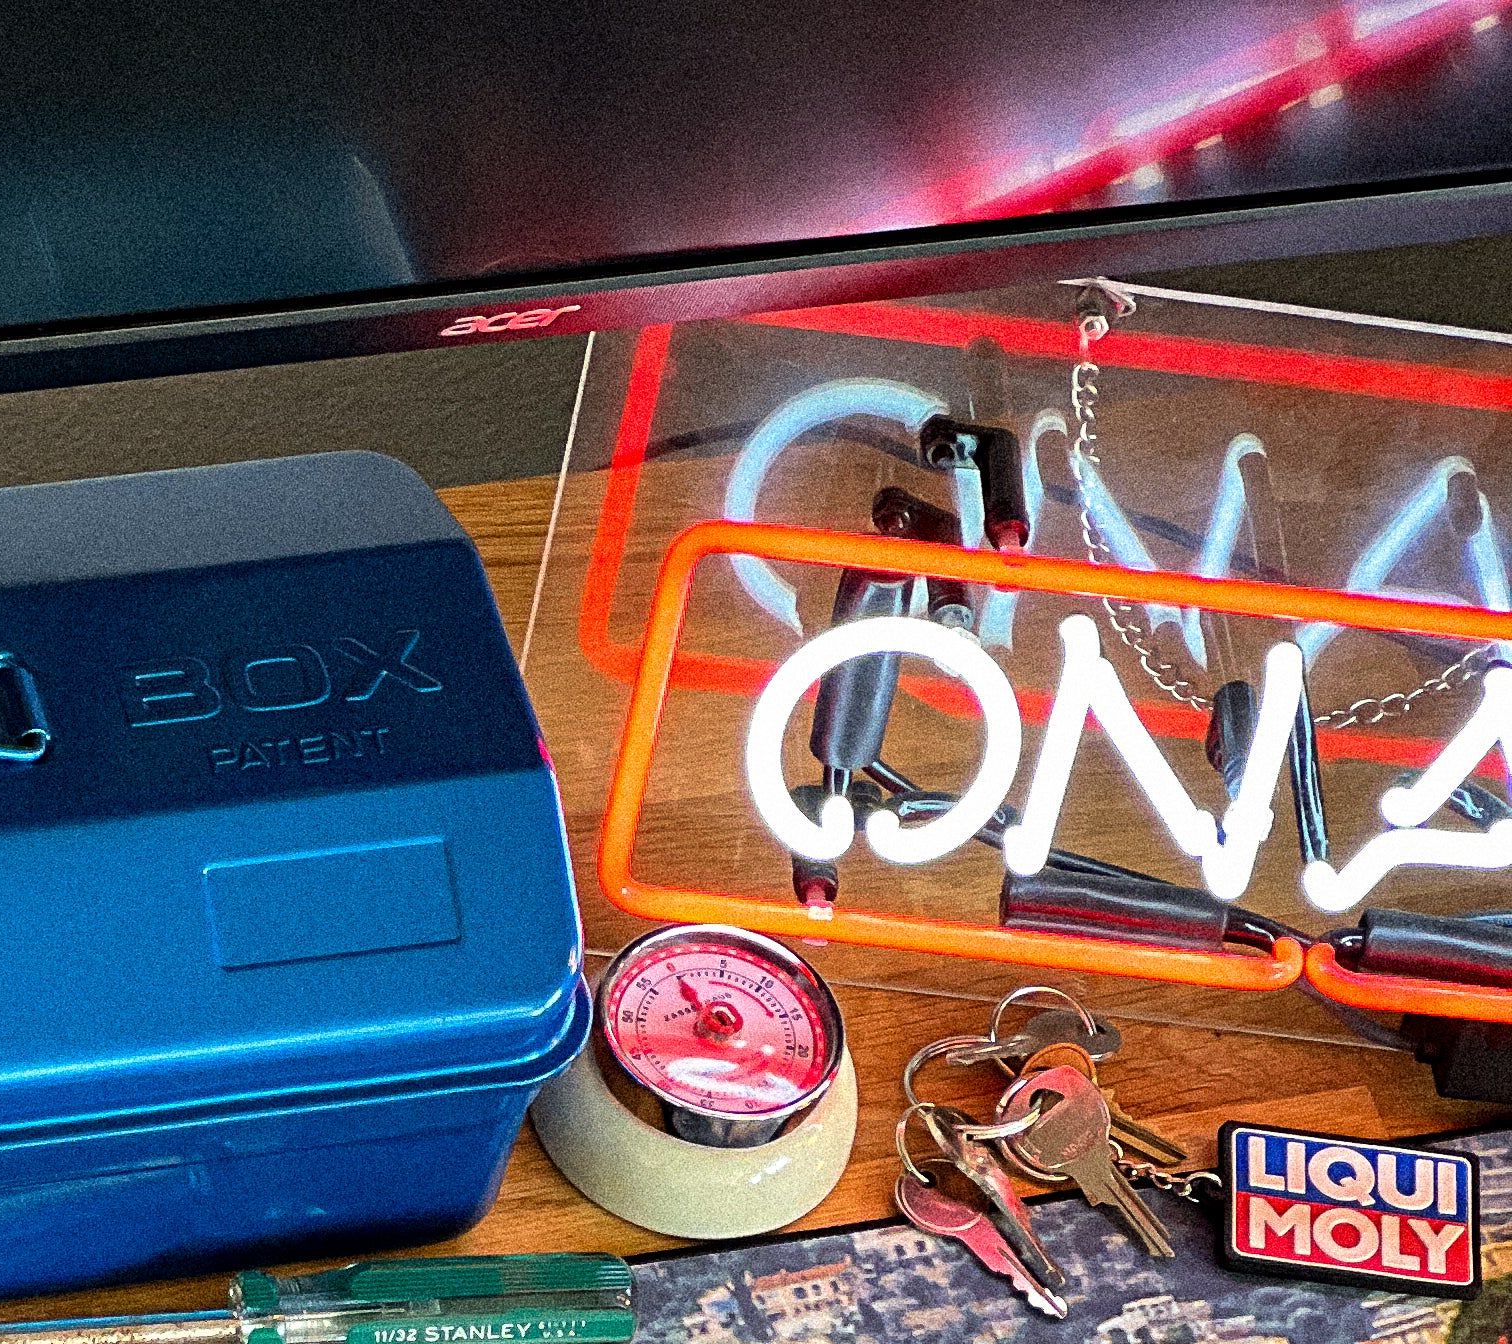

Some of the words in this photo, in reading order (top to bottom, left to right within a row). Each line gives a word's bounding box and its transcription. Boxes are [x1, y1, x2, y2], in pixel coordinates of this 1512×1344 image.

[440, 304, 582, 337] acer
[120, 628, 444, 730] BOX
[210, 726, 390, 774] PATENT
[718, 958, 729, 970] 5
[757, 974, 775, 990] 10
[788, 1007, 804, 1022] 15
[1244, 1135, 1460, 1216] LIQUI
[1245, 1196, 1466, 1276] MOLY
[374, 1328, 417, 1344] 11/32
[424, 1322, 532, 1343] STANLEY
